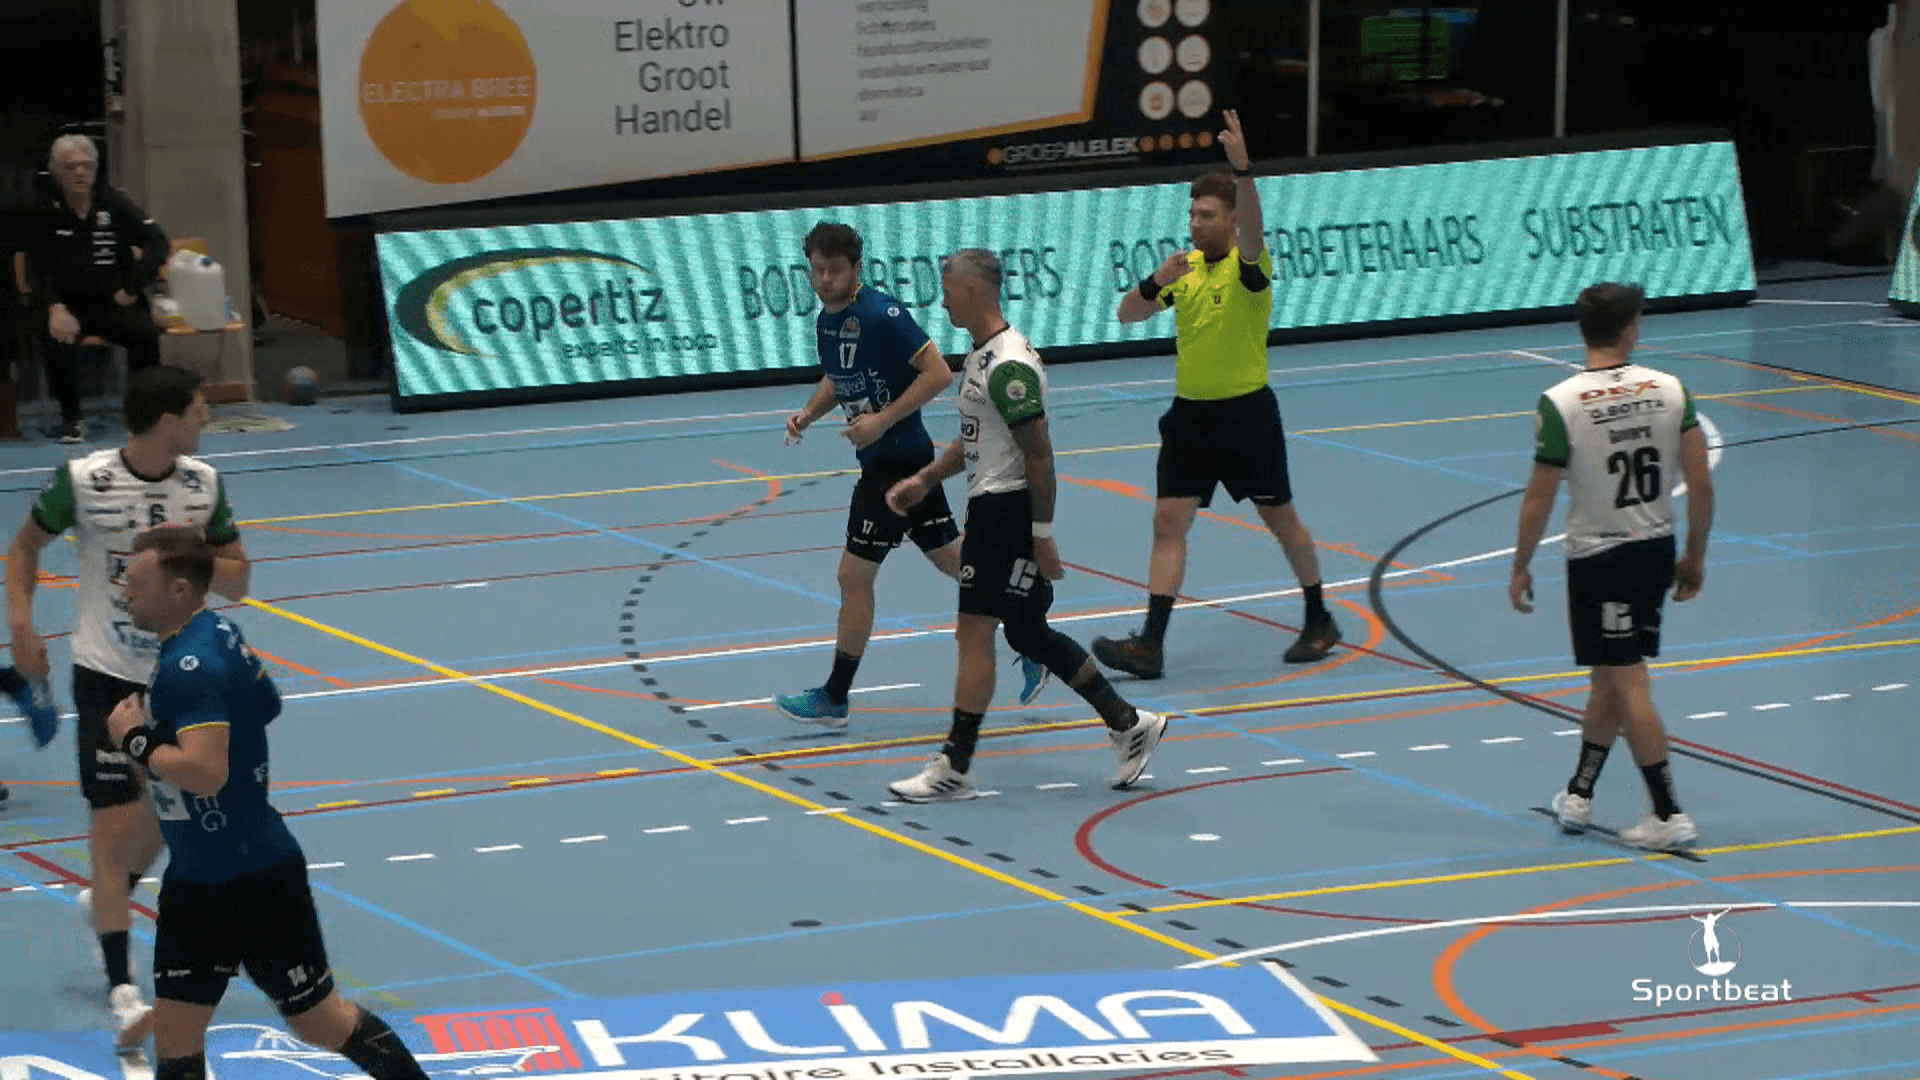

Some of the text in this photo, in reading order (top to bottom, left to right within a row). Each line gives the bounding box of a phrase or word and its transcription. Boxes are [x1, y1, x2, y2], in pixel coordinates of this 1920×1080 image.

[614, 17, 730, 52] Elektro
[362, 76, 532, 103] ELECTRA BREE
[638, 61, 730, 93] Groot
[614, 99, 732, 135] Handel
[1522, 194, 1731, 260] SUBSTRATEN
[472, 278, 668, 343] copertiz
[562, 338, 640, 363] experts
[644, 335, 667, 354] in
[839, 343, 858, 370] 17
[1607, 445, 1661, 510] 26
[150, 503, 166, 527] 6
[861, 518, 875, 535] 17
[869, 1045, 1236, 1077] Installaties
